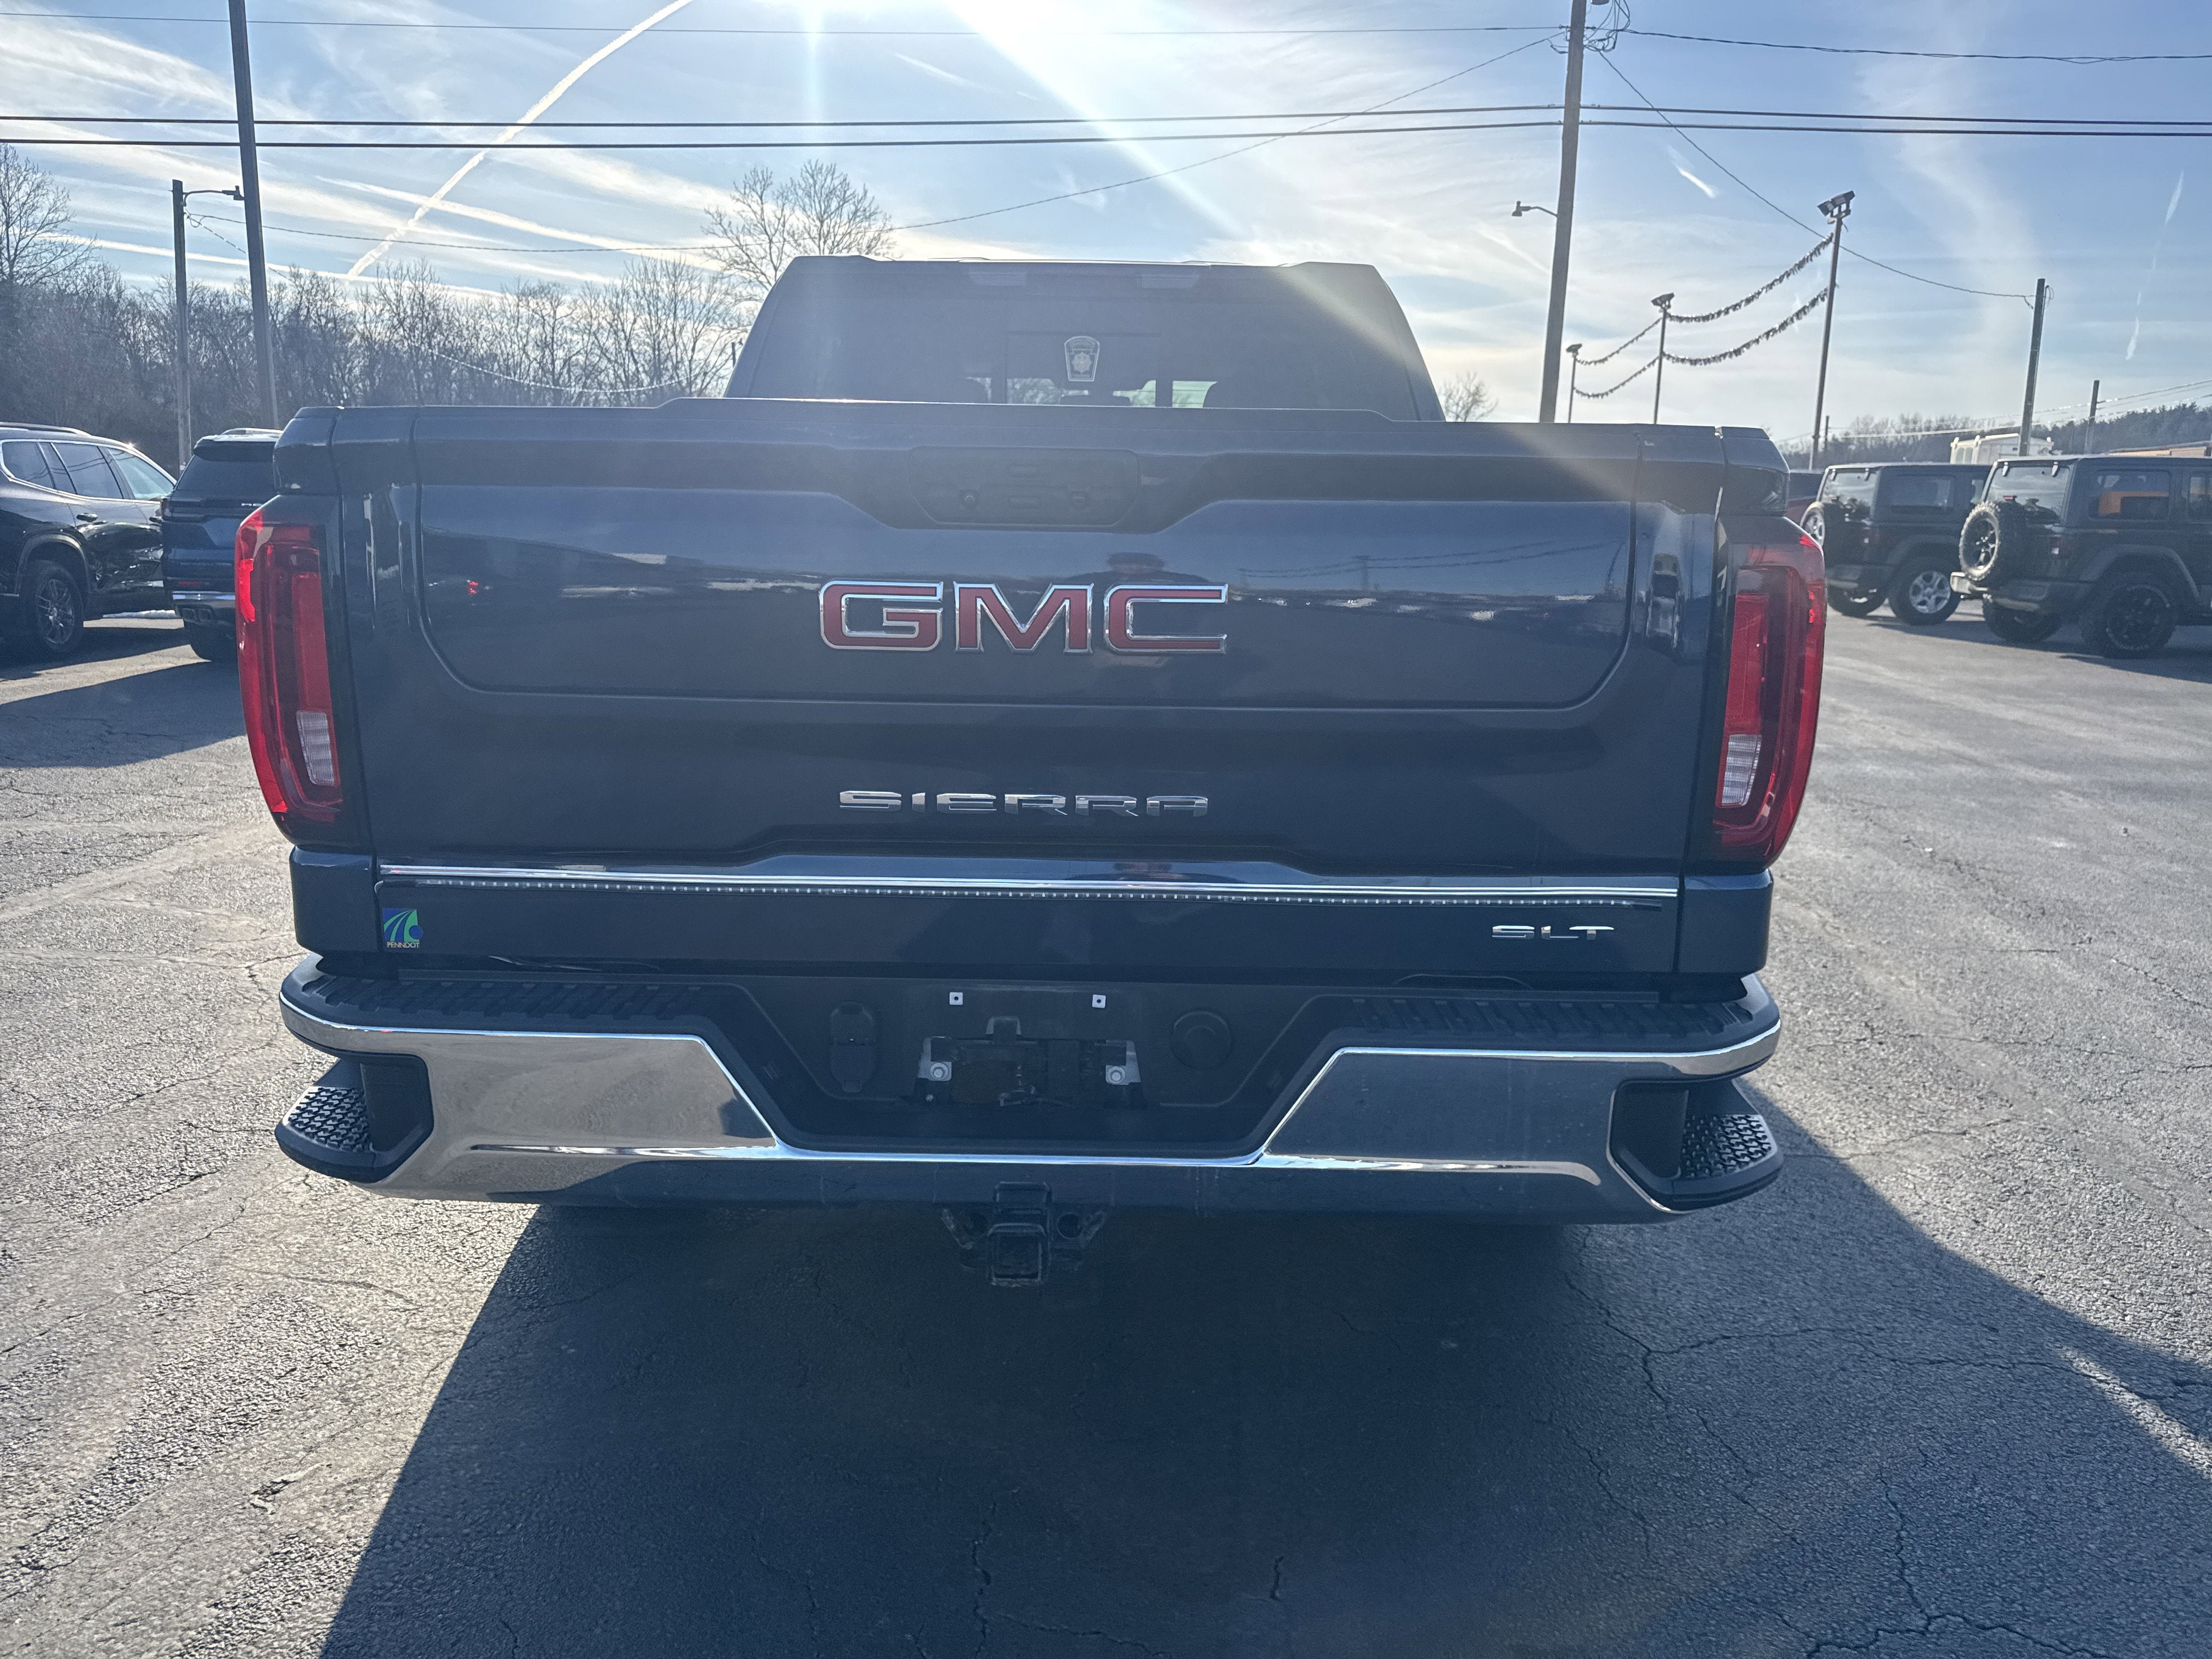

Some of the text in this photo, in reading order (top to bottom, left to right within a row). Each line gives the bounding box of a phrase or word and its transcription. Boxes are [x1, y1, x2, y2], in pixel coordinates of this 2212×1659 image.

[819, 580, 1228, 654] GMC
[839, 791, 1208, 816] SIERRA
[1492, 925, 1614, 940] SLT
